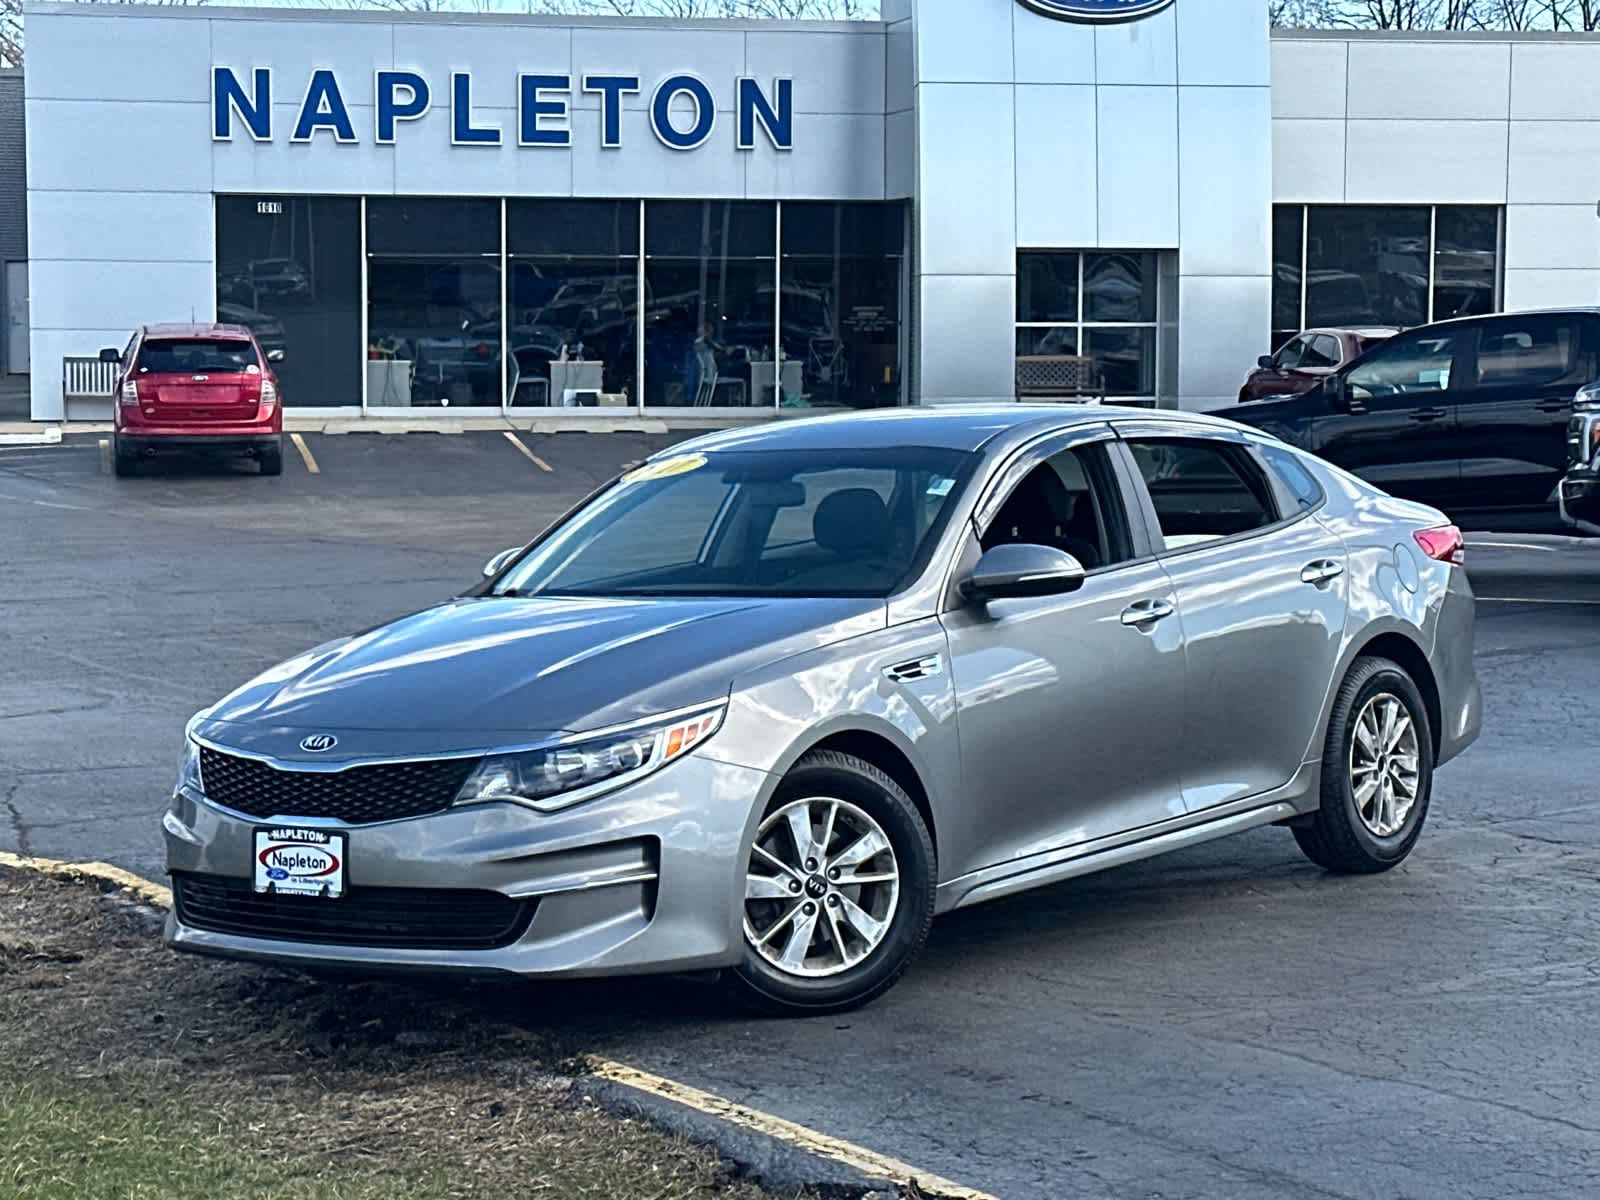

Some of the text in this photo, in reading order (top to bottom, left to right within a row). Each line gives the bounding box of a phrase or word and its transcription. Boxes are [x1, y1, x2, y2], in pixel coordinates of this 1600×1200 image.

[211, 65, 793, 151] NAPLETON
[303, 735, 332, 748] KIA
[271, 829, 325, 842] NAPLETON
[272, 851, 327, 871] Napleton
